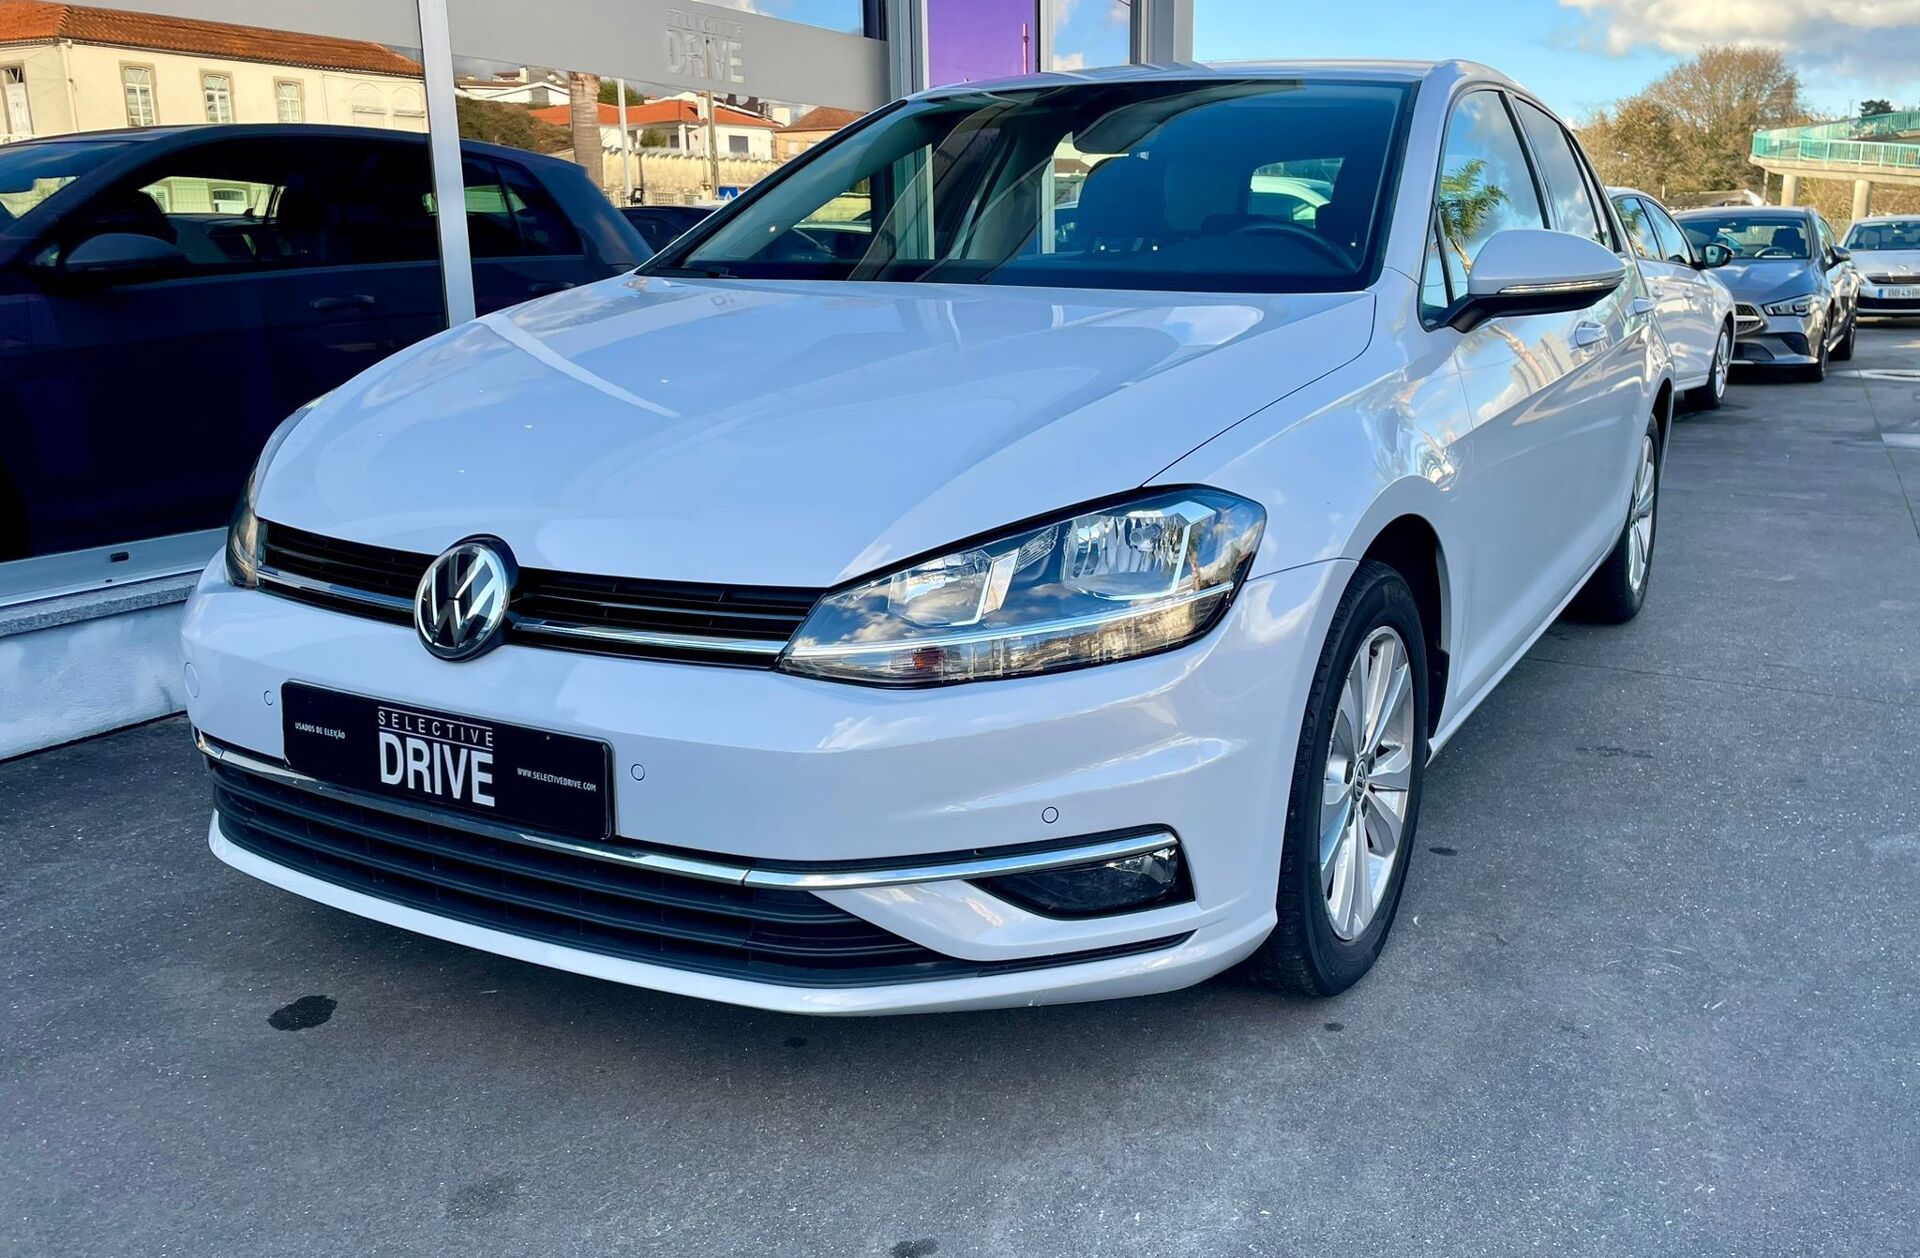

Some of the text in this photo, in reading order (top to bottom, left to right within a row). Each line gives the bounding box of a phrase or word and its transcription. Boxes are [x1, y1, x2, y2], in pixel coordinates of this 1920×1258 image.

[666, 29, 745, 83] DRIVE
[294, 721, 315, 732] USADOS
[315, 726, 324, 735] DE
[378, 710, 493, 747] SELECTIVE
[379, 731, 495, 807] DRIVE
[517, 767, 597, 792] WWW.SELECTIVEDRIVE.COM
